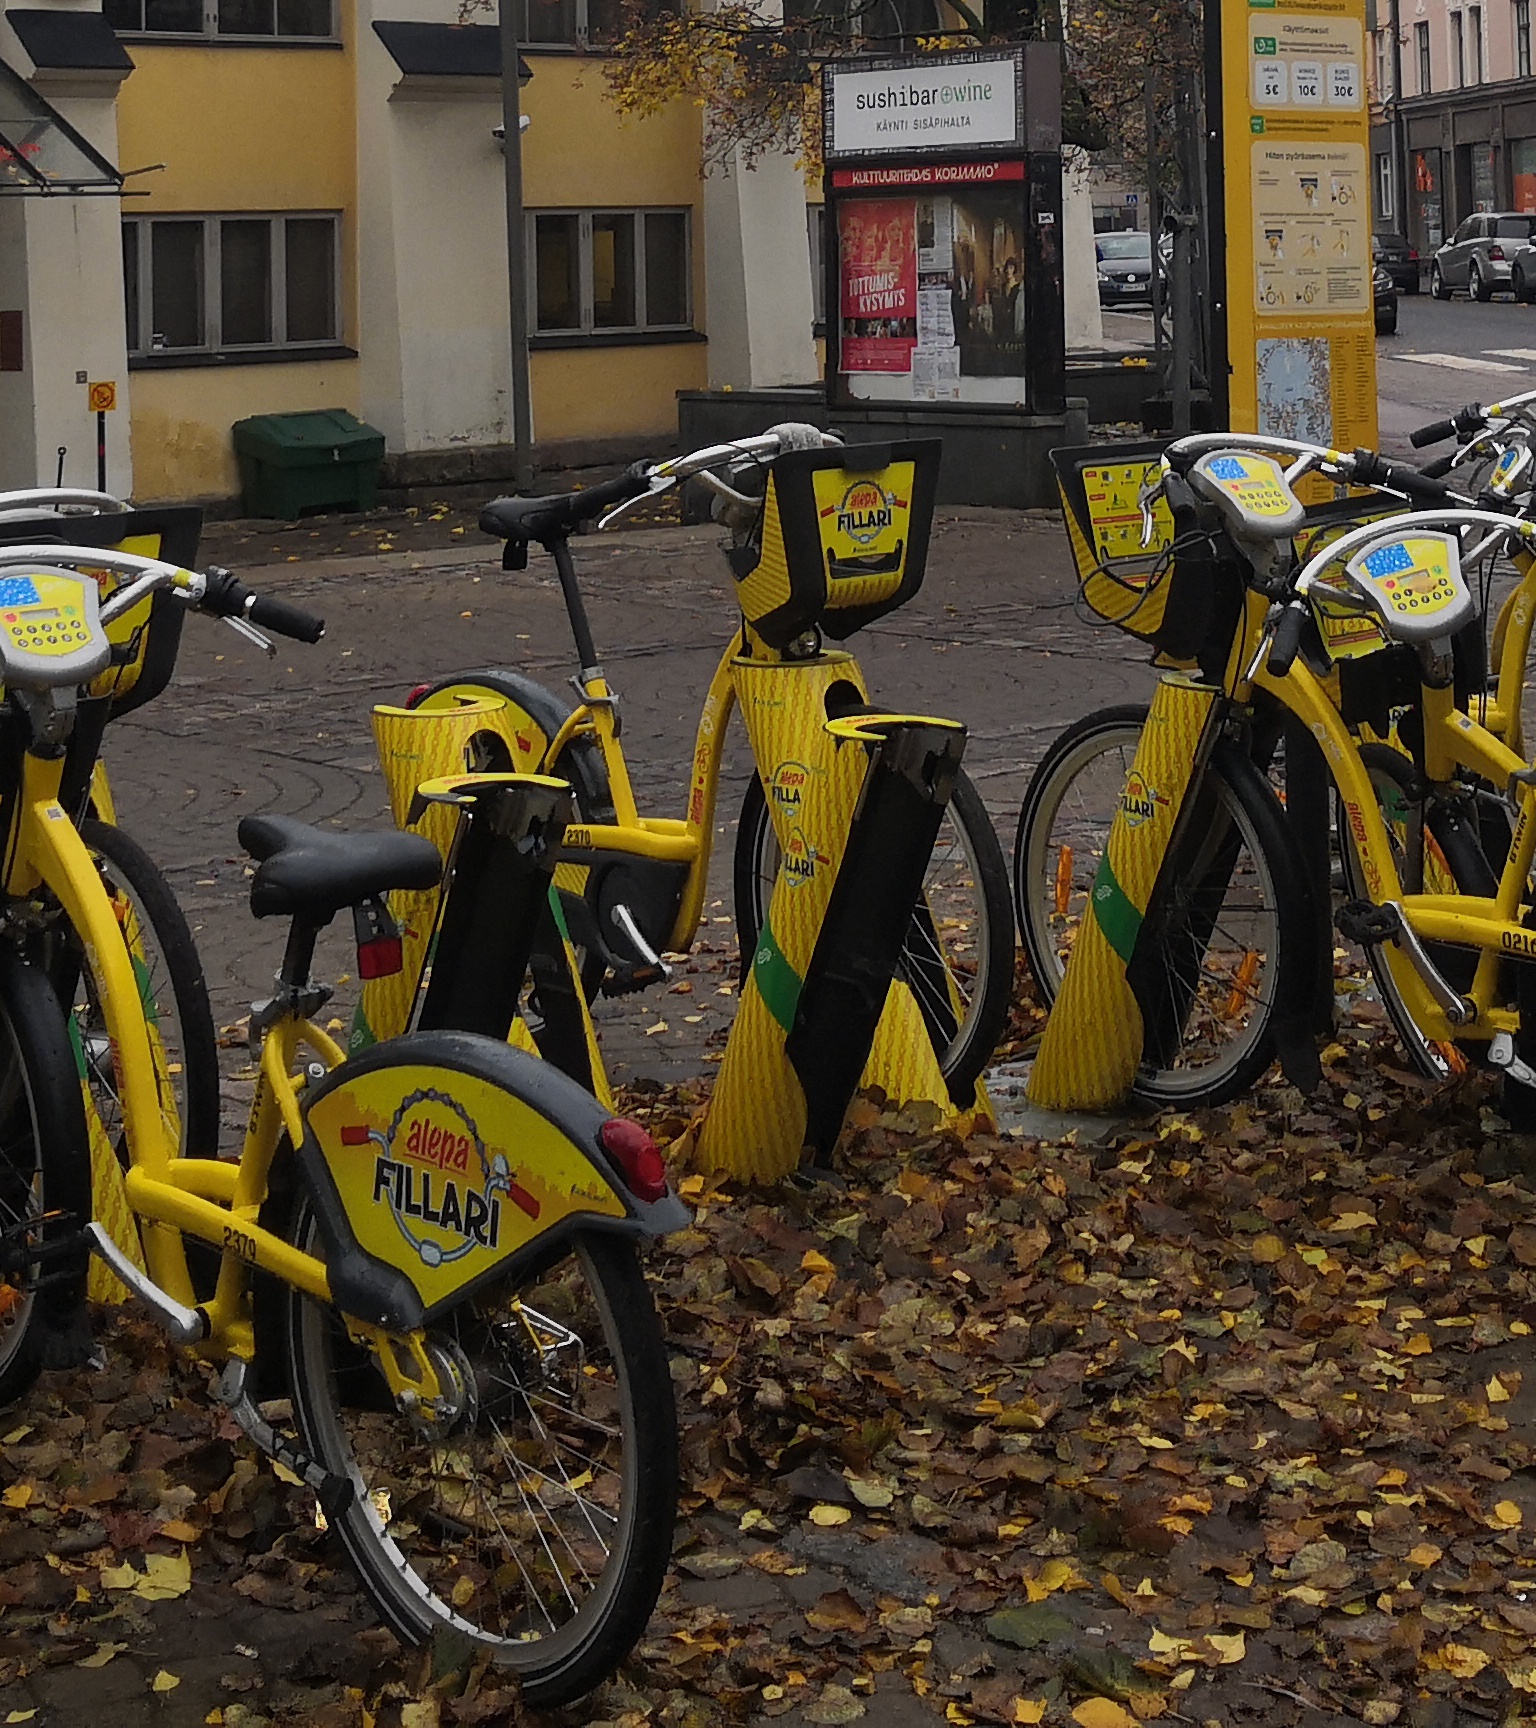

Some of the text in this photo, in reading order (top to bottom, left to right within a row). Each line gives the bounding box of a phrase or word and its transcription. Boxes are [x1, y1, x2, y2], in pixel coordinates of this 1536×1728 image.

[856, 85, 938, 110] sushibar
[876, 115, 971, 132] KÄYNTI SISÄPIHALTA
[935, 163, 994, 181] KORJAAMO
[849, 272, 899, 296] TOTTUMIS-
[859, 288, 905, 313] KYSYMYS
[850, 490, 878, 509] alepa
[837, 508, 892, 532] FILLARI
[566, 828, 591, 845] 2370
[406, 1117, 470, 1171] alepa
[372, 1155, 501, 1249] FILLARI
[222, 1225, 257, 1262] 2379
